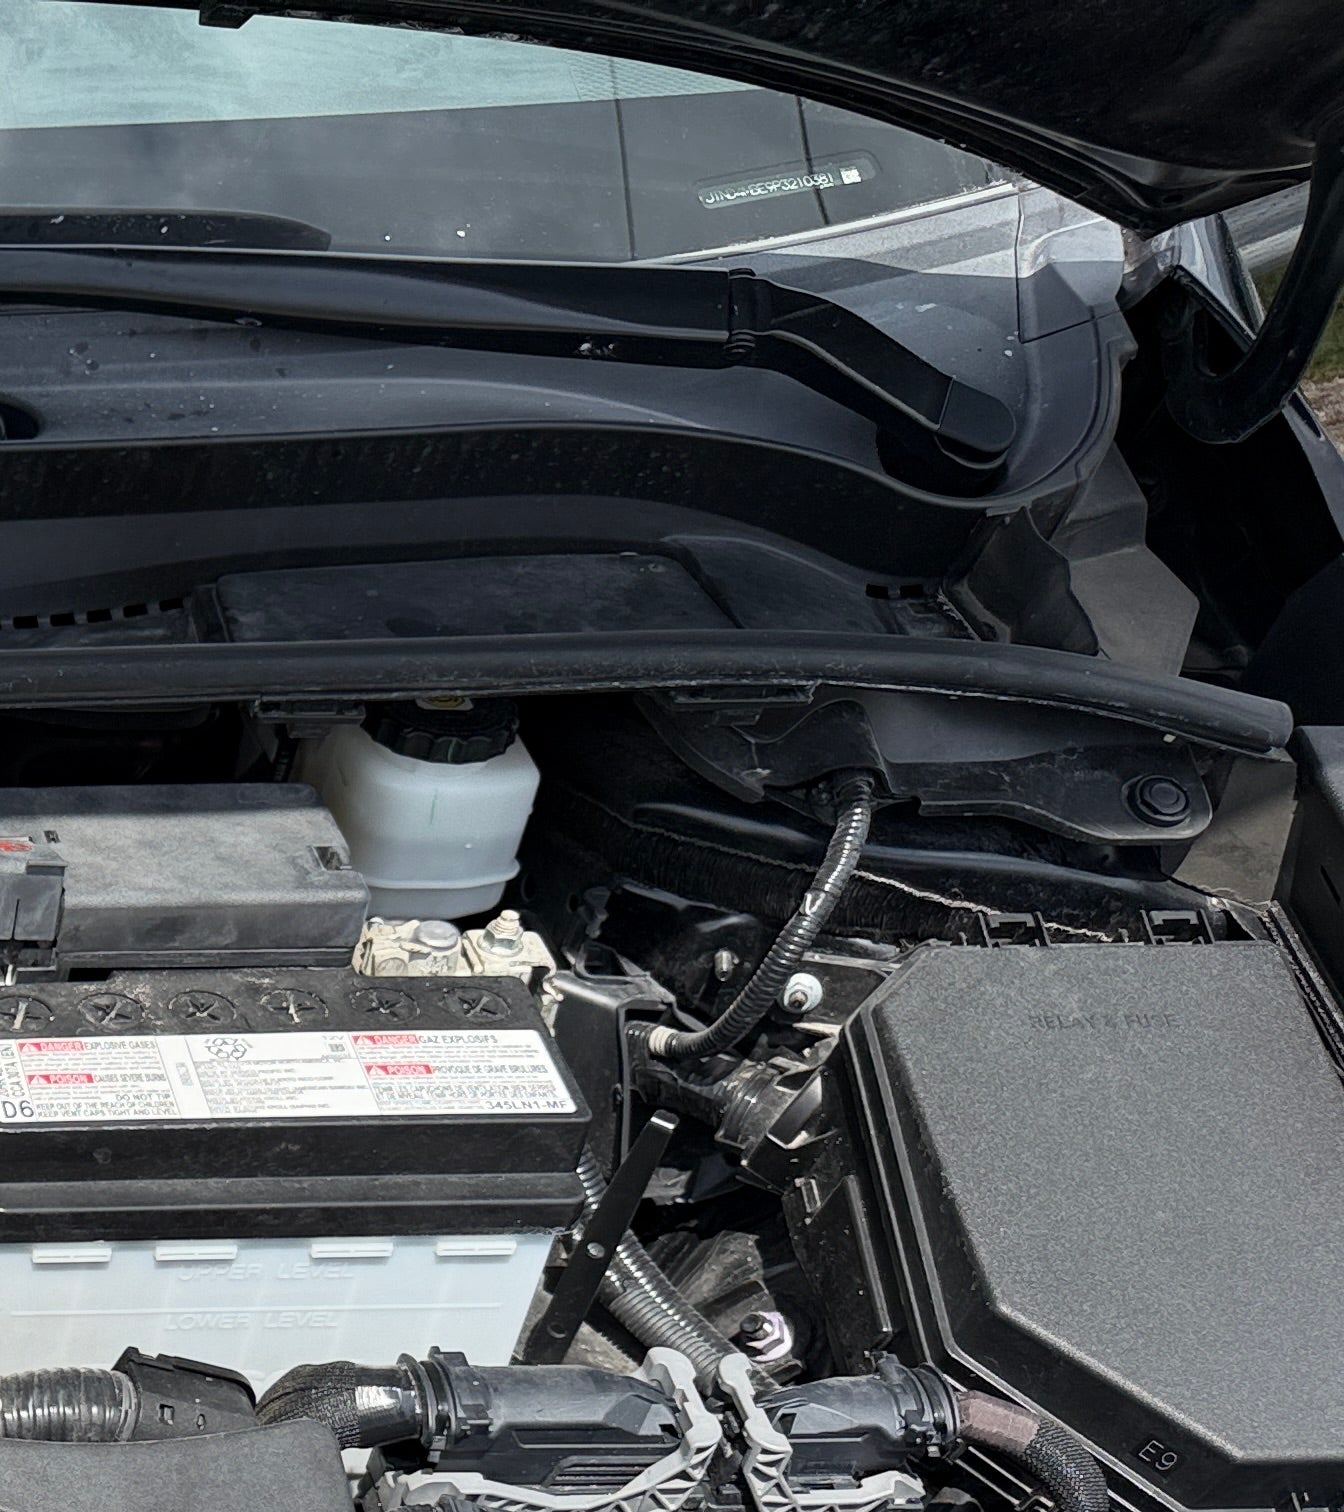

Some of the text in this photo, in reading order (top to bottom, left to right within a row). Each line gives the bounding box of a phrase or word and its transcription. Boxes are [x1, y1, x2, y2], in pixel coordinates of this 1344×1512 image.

[40, 1039, 157, 1052] DANGER EXPLOSIVE GASES
[373, 1034, 499, 1045] DANGER GAZ EXPLOSIFS
[386, 1065, 427, 1075] POISON
[48, 1074, 88, 1084] POISON
[133, 1093, 152, 1101] NOT
[1, 1100, 35, 1119] D6
[177, 1261, 354, 1282] UPPER LEVEL
[164, 1310, 339, 1331] LOWER LEVEL
[1138, 1439, 1178, 1471] E9
